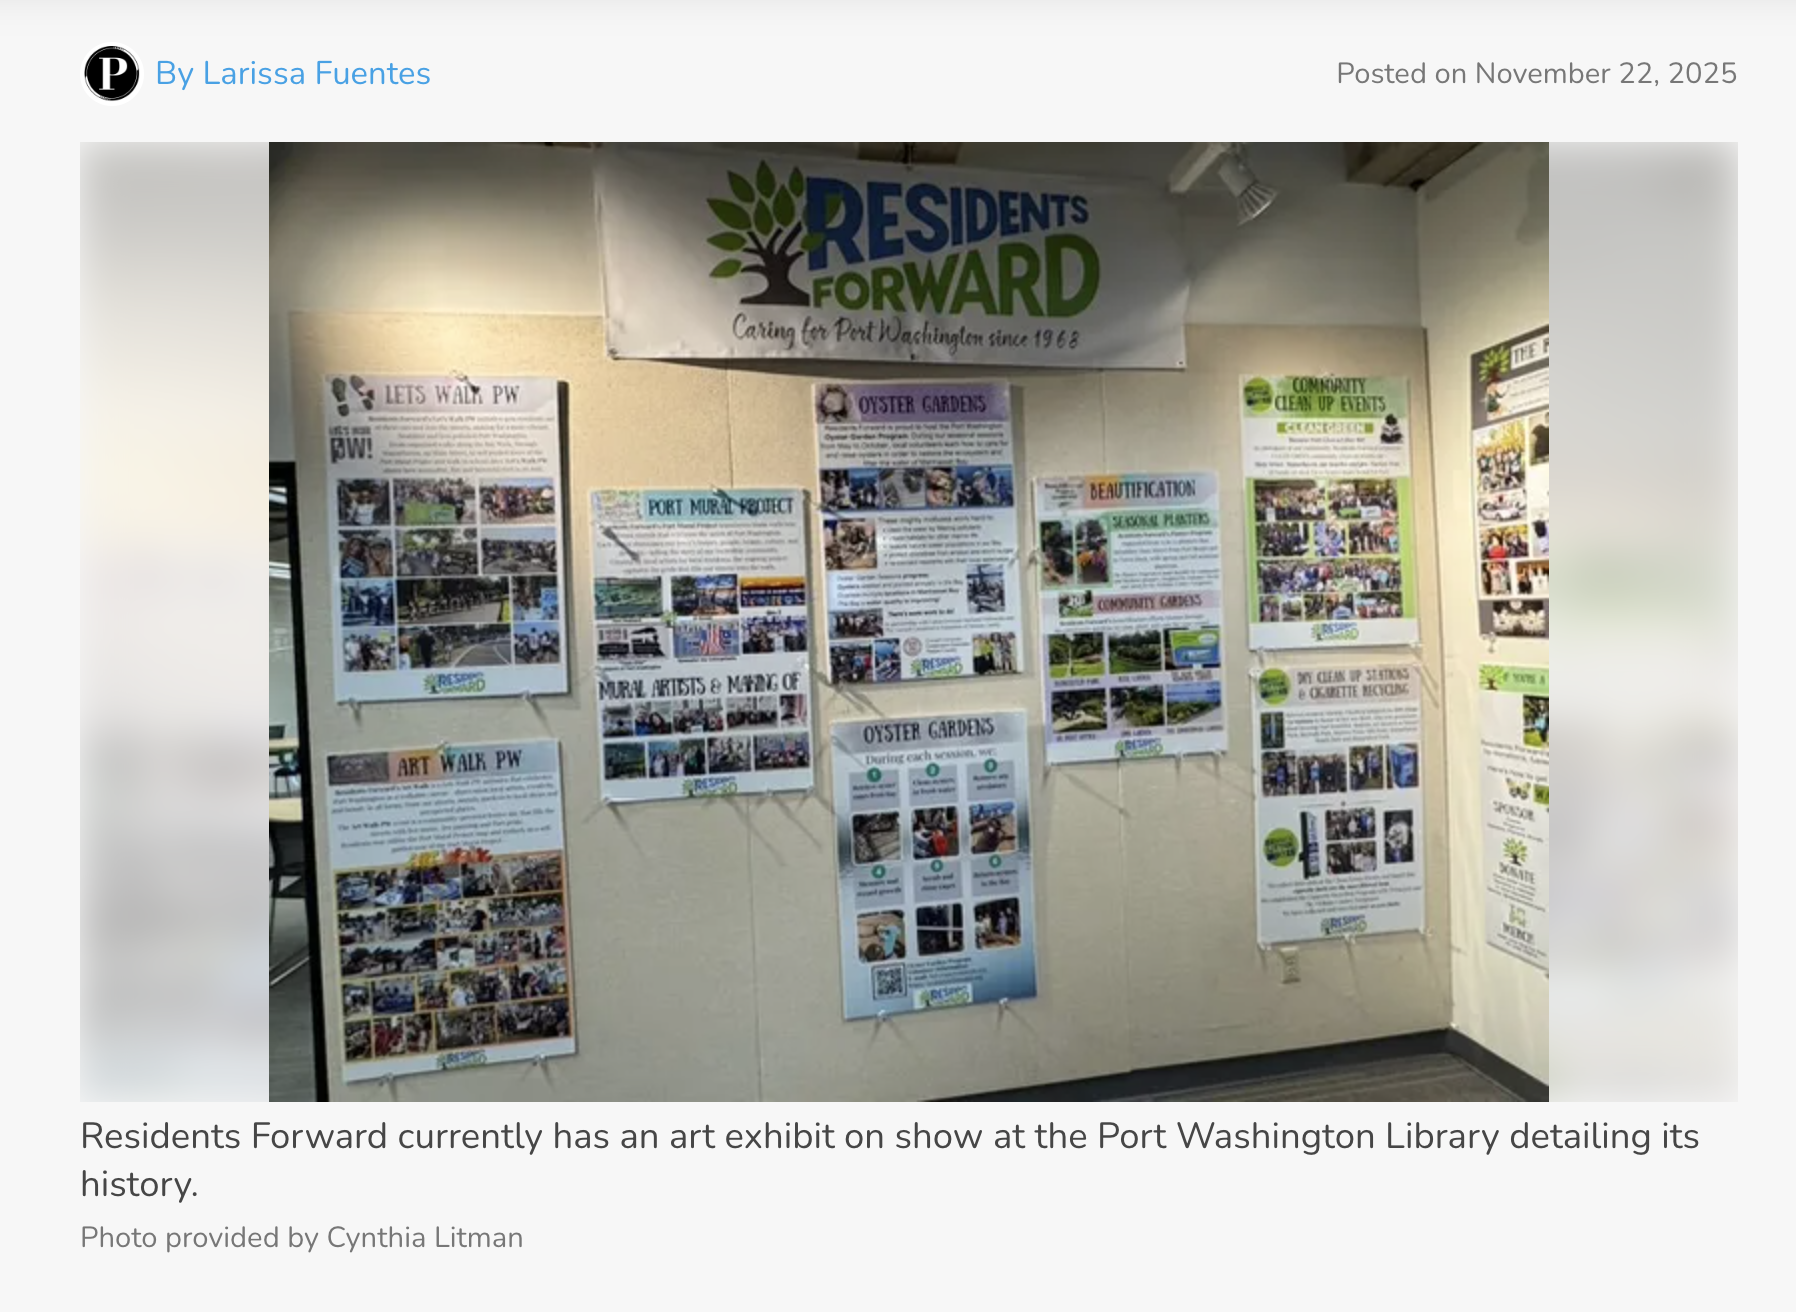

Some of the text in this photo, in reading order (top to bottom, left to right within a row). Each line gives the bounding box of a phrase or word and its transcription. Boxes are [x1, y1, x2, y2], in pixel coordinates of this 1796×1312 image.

[806, 175, 1089, 270] RESIDENTS
[812, 233, 1099, 318] FORWARD
[732, 313, 1080, 354] Caring for Port Washington since 1968
[1513, 342, 1536, 364] THE
[385, 385, 520, 404] LETS WALK PW
[1292, 377, 1367, 394] COMMUNITY
[858, 395, 988, 414] OYSTER GARDENS
[1274, 395, 1387, 413] CLEAN UP EVENTS
[1090, 479, 1196, 500] BEAUTIFICATION
[648, 498, 683, 516] PORT
[690, 498, 735, 516] MURAL
[1112, 512, 1210, 528] SEASONAL PLANTERS
[1097, 594, 1203, 612] COMMUNITY GARDENS
[599, 679, 648, 700] MURAL
[651, 676, 706, 697] ARTISTS
[727, 673, 779, 694] MAKING
[782, 672, 801, 690] OF
[1297, 668, 1410, 685] DIY CLEAN UP STATIONS
[1309, 685, 1358, 699] CIGARETTE
[1362, 683, 1410, 697] RECYCLING
[863, 717, 995, 744] OYSTER GARDENS
[397, 749, 523, 777] ART WALK PW
[866, 752, 904, 765] During
[906, 750, 932, 763] each
[1492, 800, 1535, 822] SPONSOR
[1499, 861, 1535, 885] DONATE
